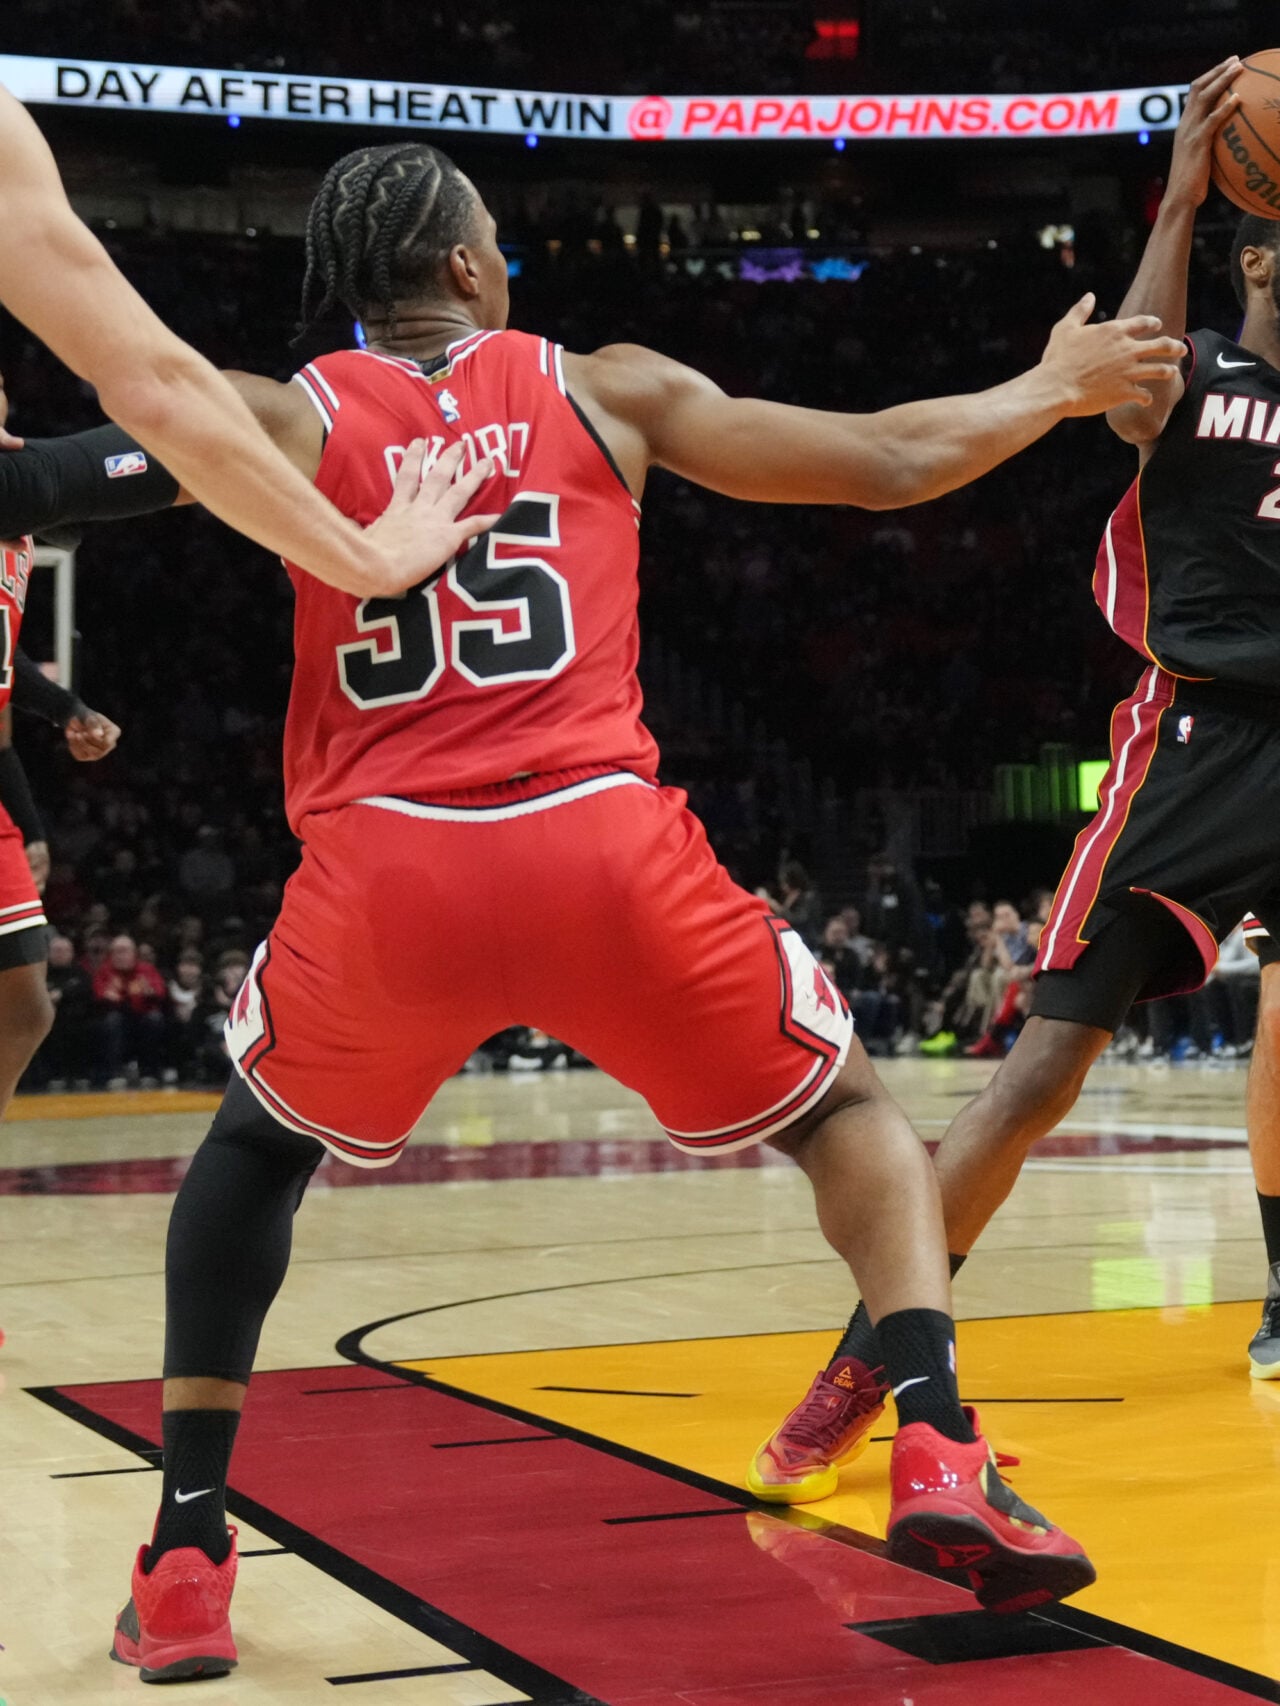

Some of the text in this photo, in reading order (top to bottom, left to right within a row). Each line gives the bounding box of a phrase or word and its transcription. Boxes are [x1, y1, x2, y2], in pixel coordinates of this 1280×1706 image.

[57, 66, 159, 104] DAY
[181, 75, 351, 117] AFTER
[368, 87, 498, 126] HEAT
[514, 97, 611, 133] WIN
[627, 95, 673, 141] @
[682, 95, 1120, 135] PAPAJOHNS.COM
[335, 490, 577, 711] 35
[833, 1377, 855, 1389] PEAK
